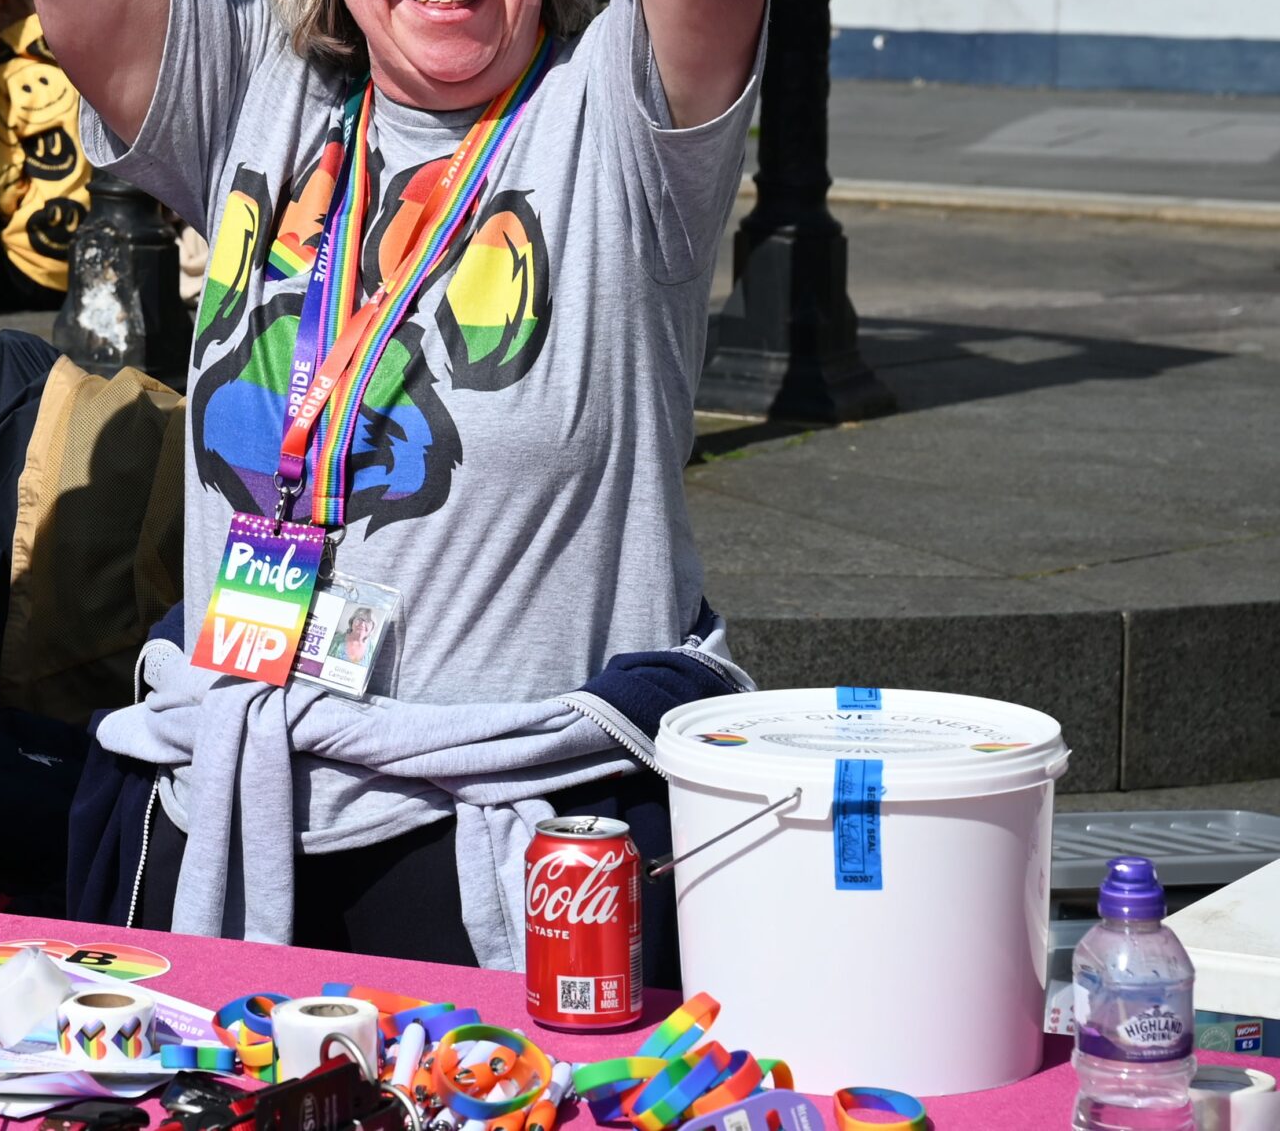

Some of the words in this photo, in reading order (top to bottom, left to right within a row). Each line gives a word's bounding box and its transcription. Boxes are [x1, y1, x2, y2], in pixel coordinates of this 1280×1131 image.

[288, 360, 311, 417] PRIDE
[295, 375, 334, 429] PRIDE
[224, 541, 309, 593] Pride
[211, 616, 288, 673] VIP
[805, 713, 873, 721] GIVE
[866, 828, 876, 854] SEAL
[526, 851, 625, 925] Cola
[534, 926, 570, 940] TASTE
[601, 980, 618, 991] SCAN
[603, 990, 616, 999] FOR
[600, 999, 619, 1009] MORE
[1124, 1020, 1184, 1039] HIGHLAND
[1141, 1032, 1172, 1043] SPRING
